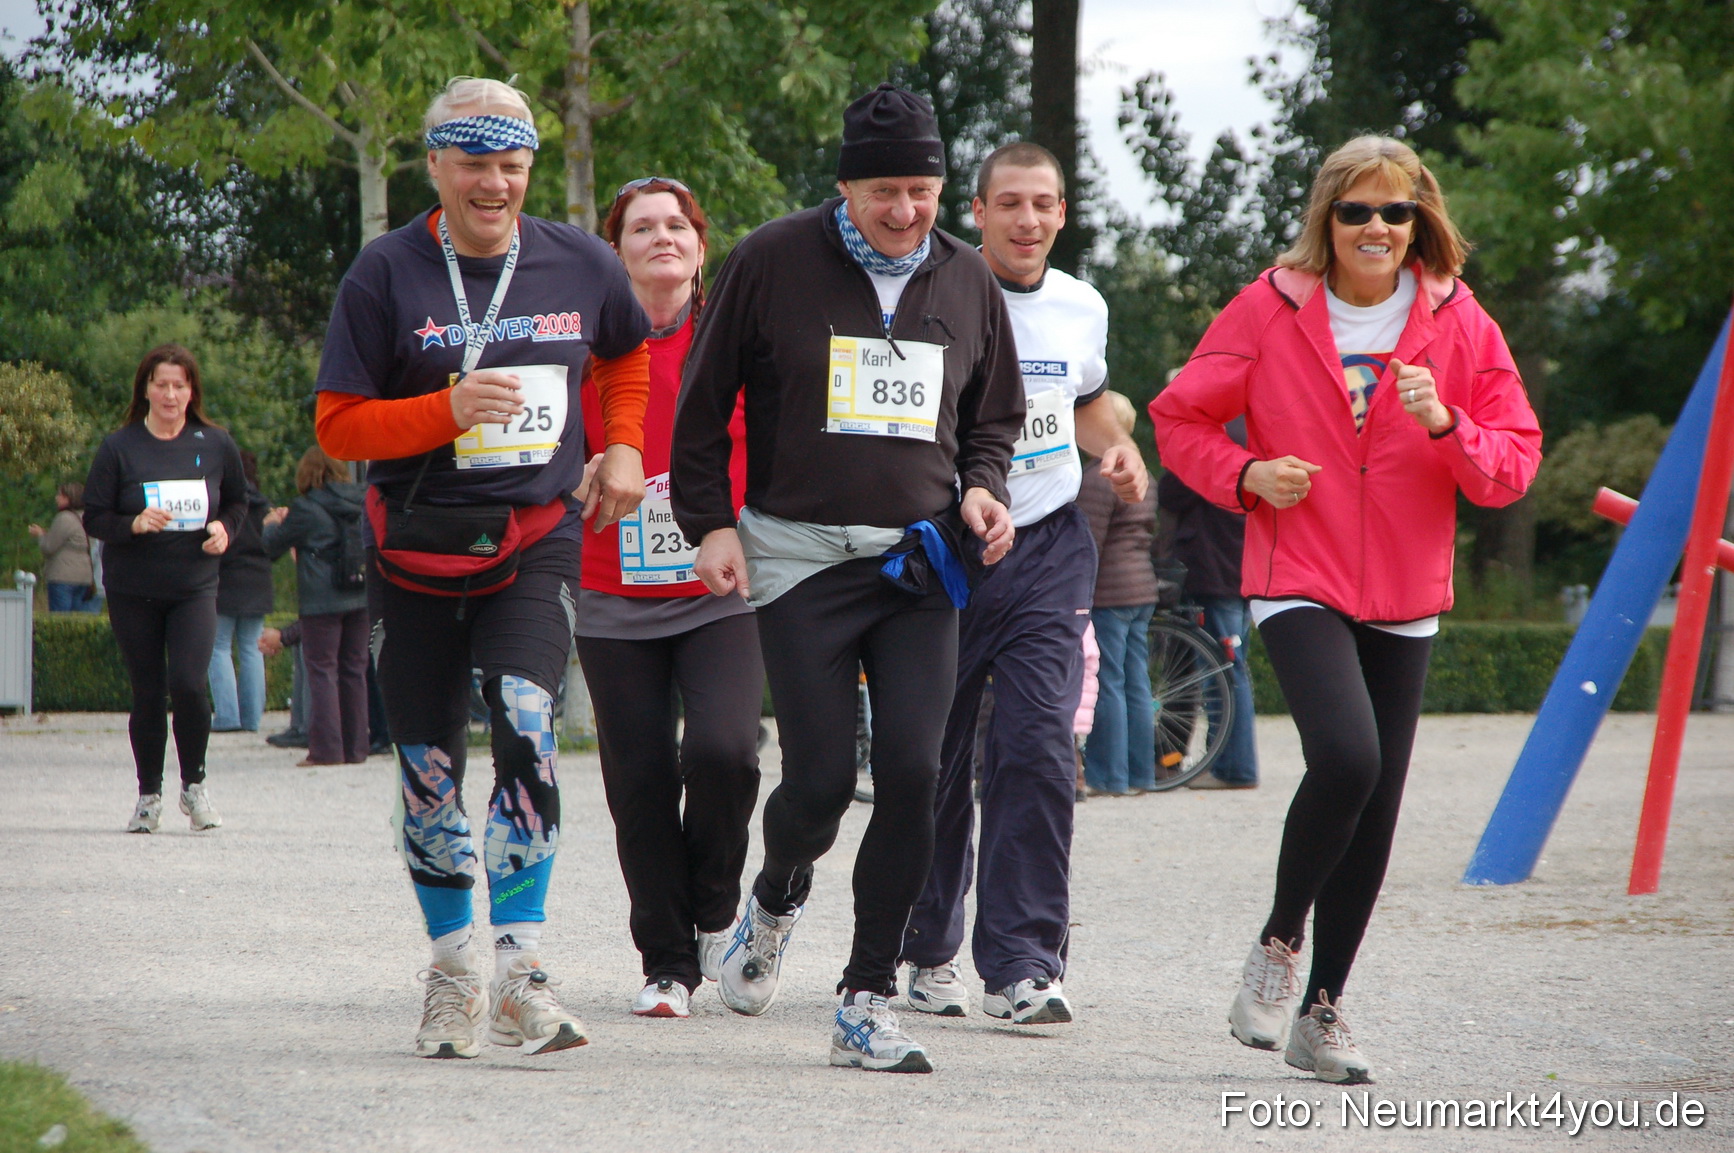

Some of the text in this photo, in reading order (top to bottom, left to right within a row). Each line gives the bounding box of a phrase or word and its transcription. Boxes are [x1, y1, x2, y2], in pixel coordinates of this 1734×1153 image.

[862, 348, 892, 367] Karl
[834, 374, 842, 388] D
[872, 378, 926, 407] 836
[165, 498, 201, 512] 3456
[626, 532, 633, 544] D
